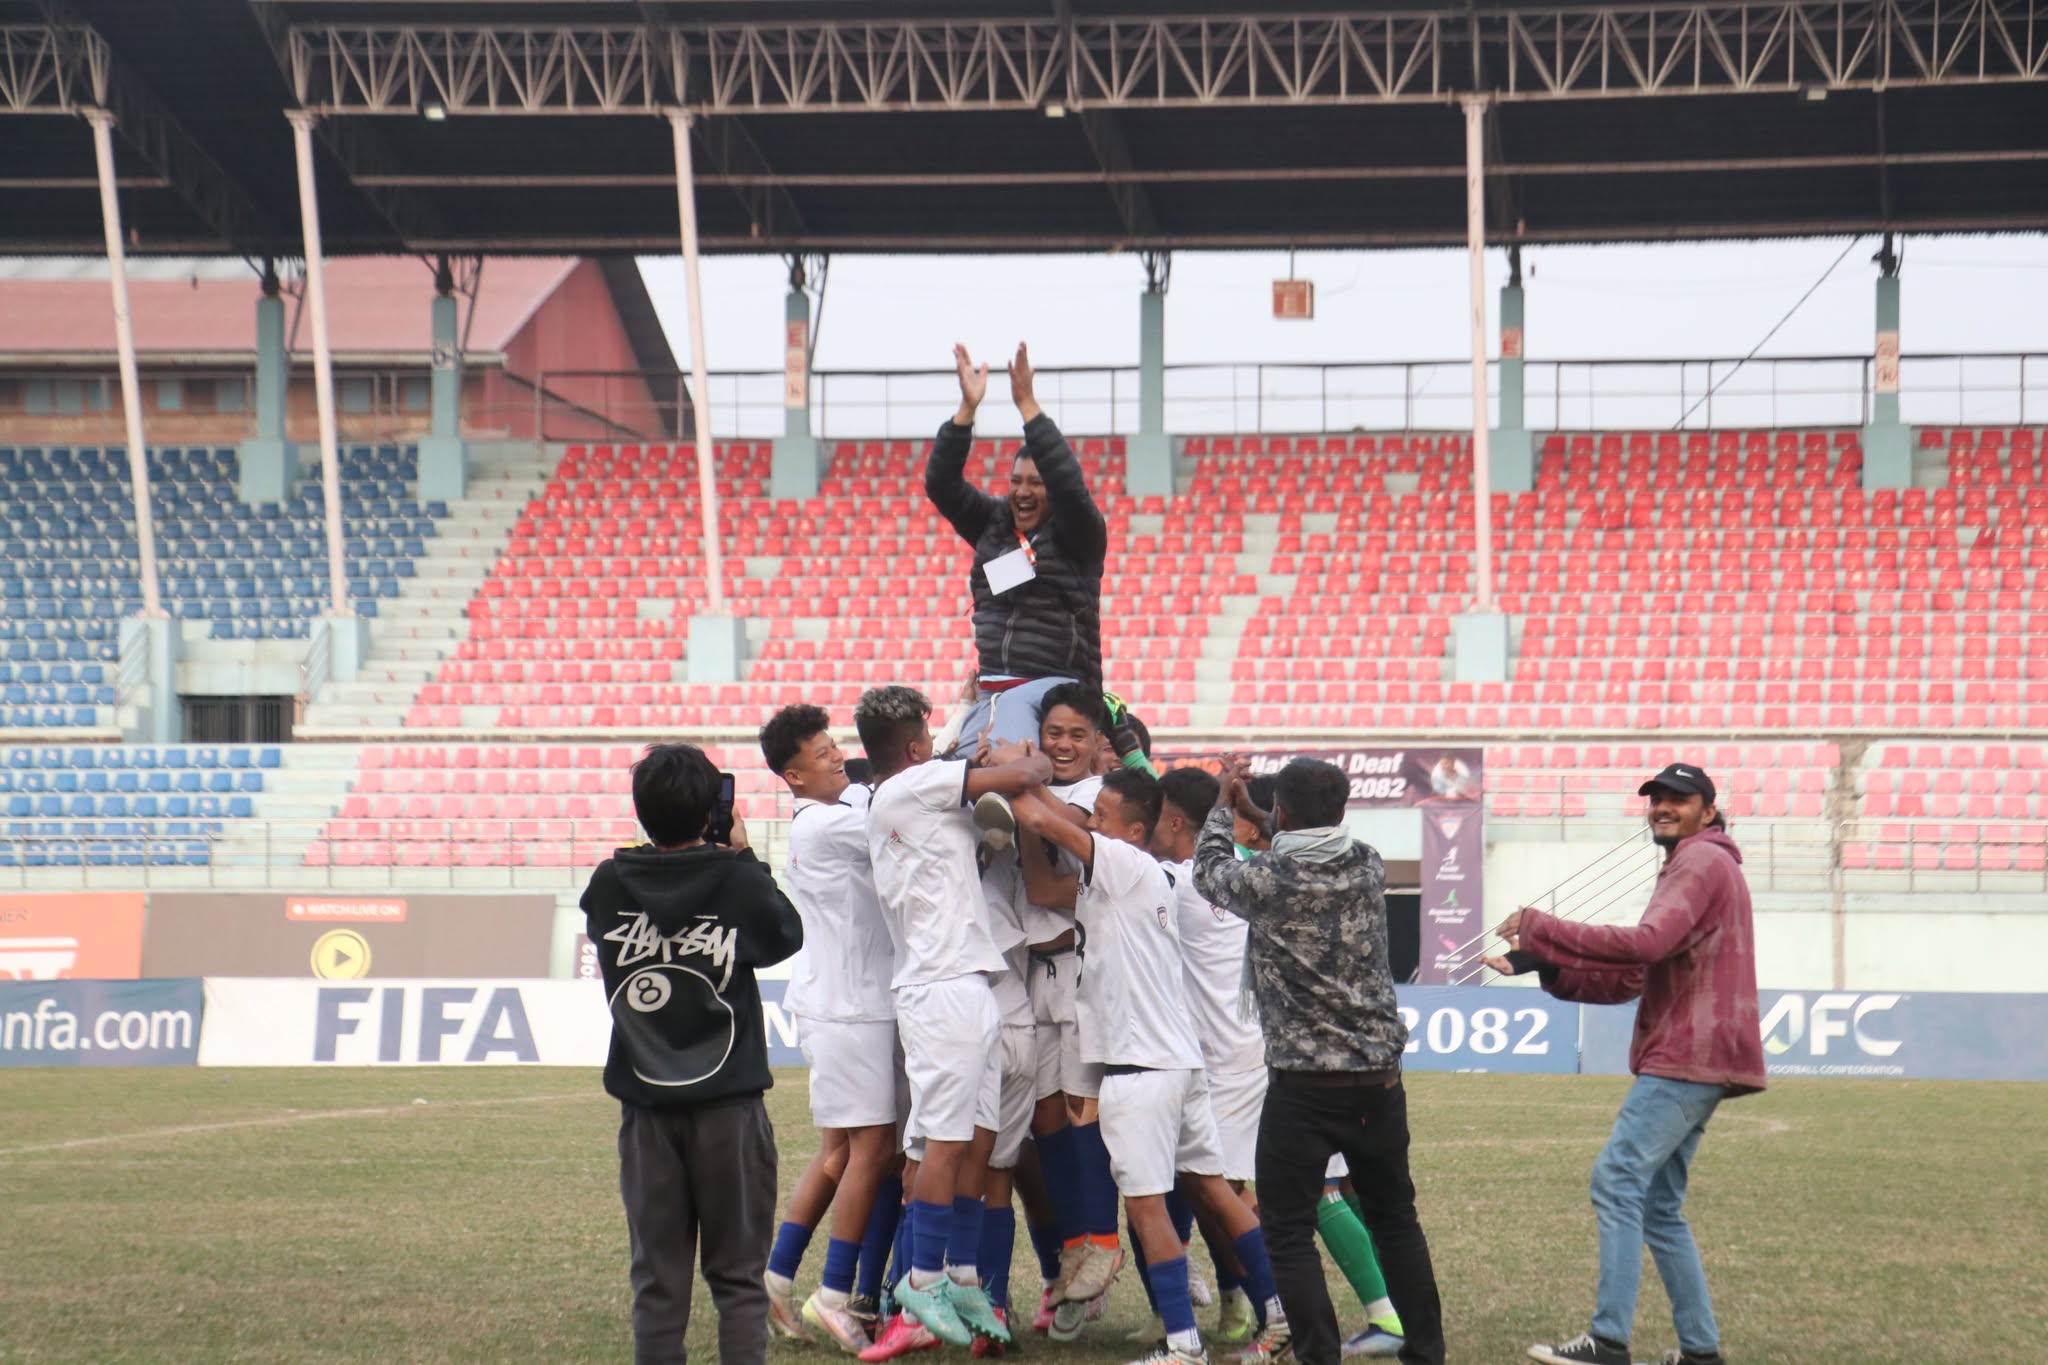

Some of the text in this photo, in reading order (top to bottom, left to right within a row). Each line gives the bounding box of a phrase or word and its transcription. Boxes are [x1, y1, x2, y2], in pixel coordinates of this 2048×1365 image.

[1348, 753, 1404, 775] Deaf
[1348, 778, 1406, 799] 2082
[352, 904, 379, 916] LIVE
[580, 943, 598, 979] 082
[636, 977, 662, 1004] 8
[0, 998, 193, 1051] nfa.com
[313, 987, 541, 1062] FIFA
[1397, 1006, 1550, 1055] 2082
[1759, 994, 1904, 1057] AFC
[1768, 1064, 1905, 1076] FOOTBALL CONFEDERATION
